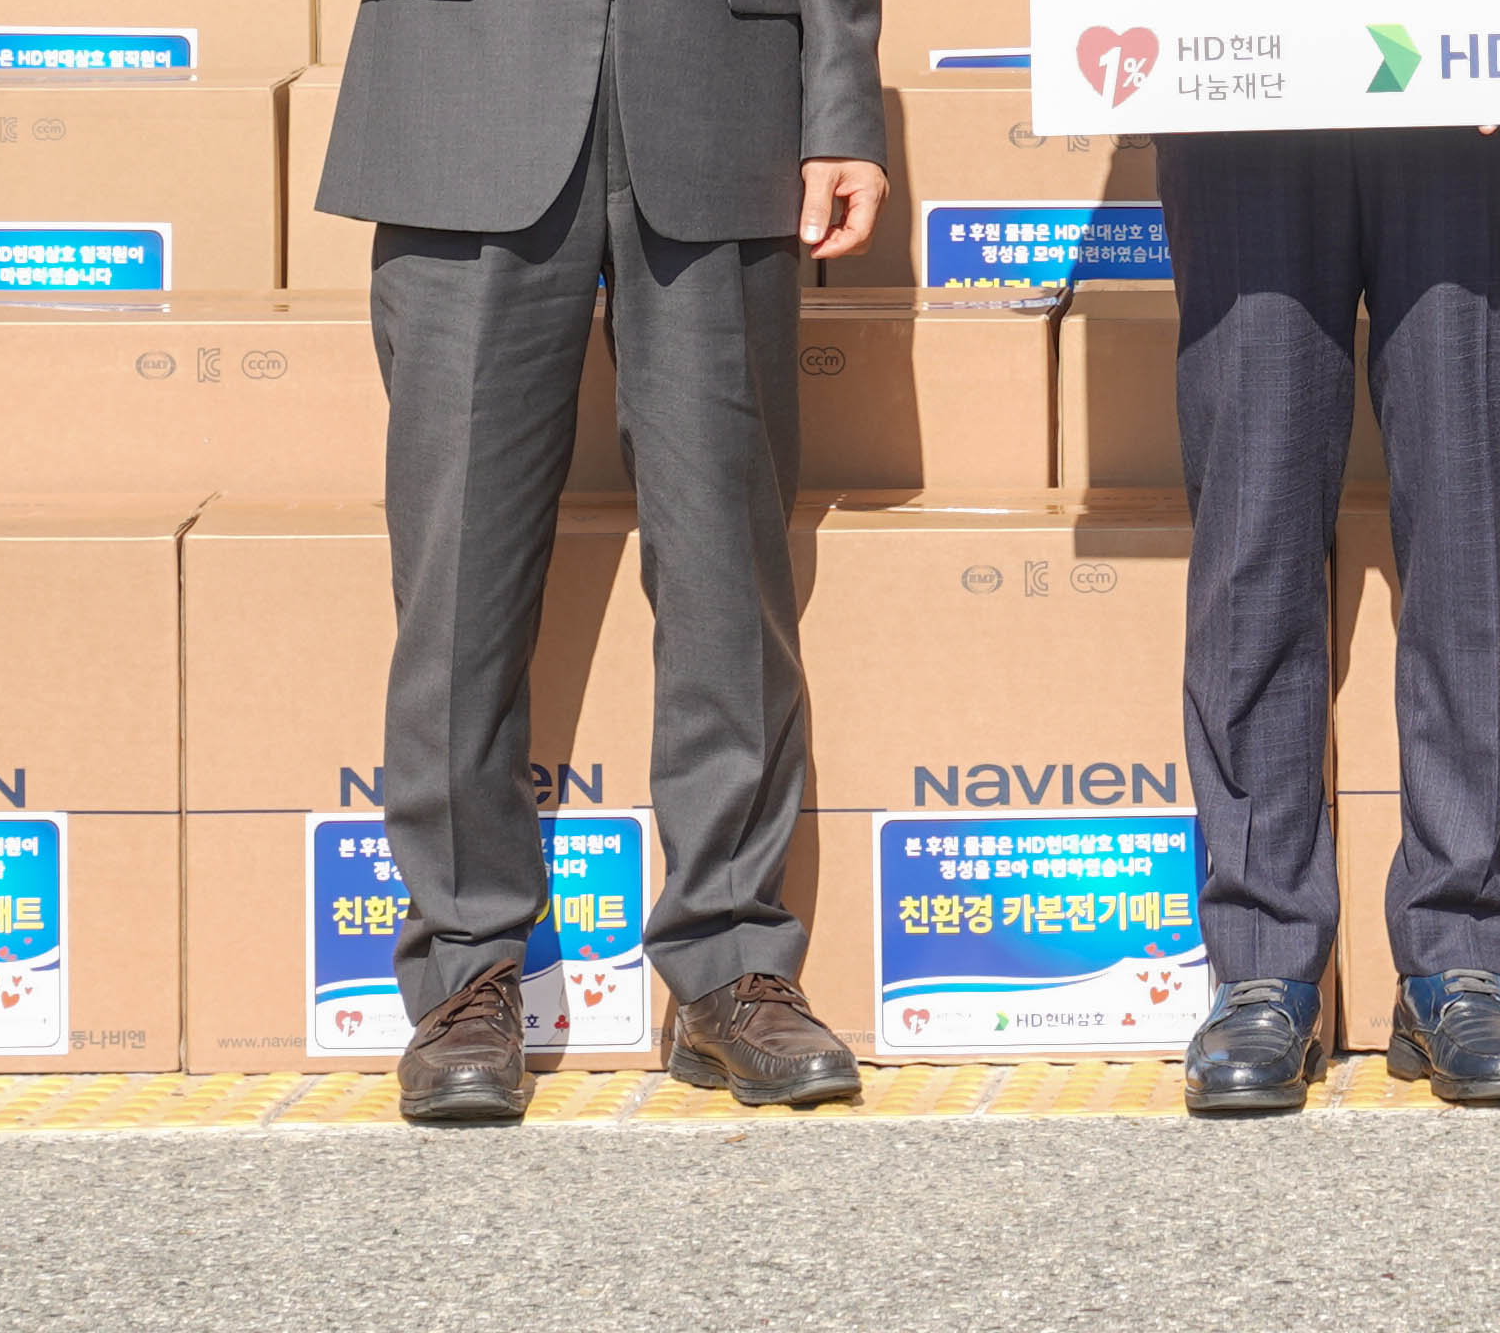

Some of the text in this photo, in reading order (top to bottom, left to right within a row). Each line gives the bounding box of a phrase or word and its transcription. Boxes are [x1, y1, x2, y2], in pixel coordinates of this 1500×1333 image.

[1178, 35, 1281, 62] HD현대
[1178, 72, 1285, 101] 나눔재단
[898, 891, 1192, 934] 친환경 카본전기매트
[68, 1030, 146, 1050] 동나비엔
